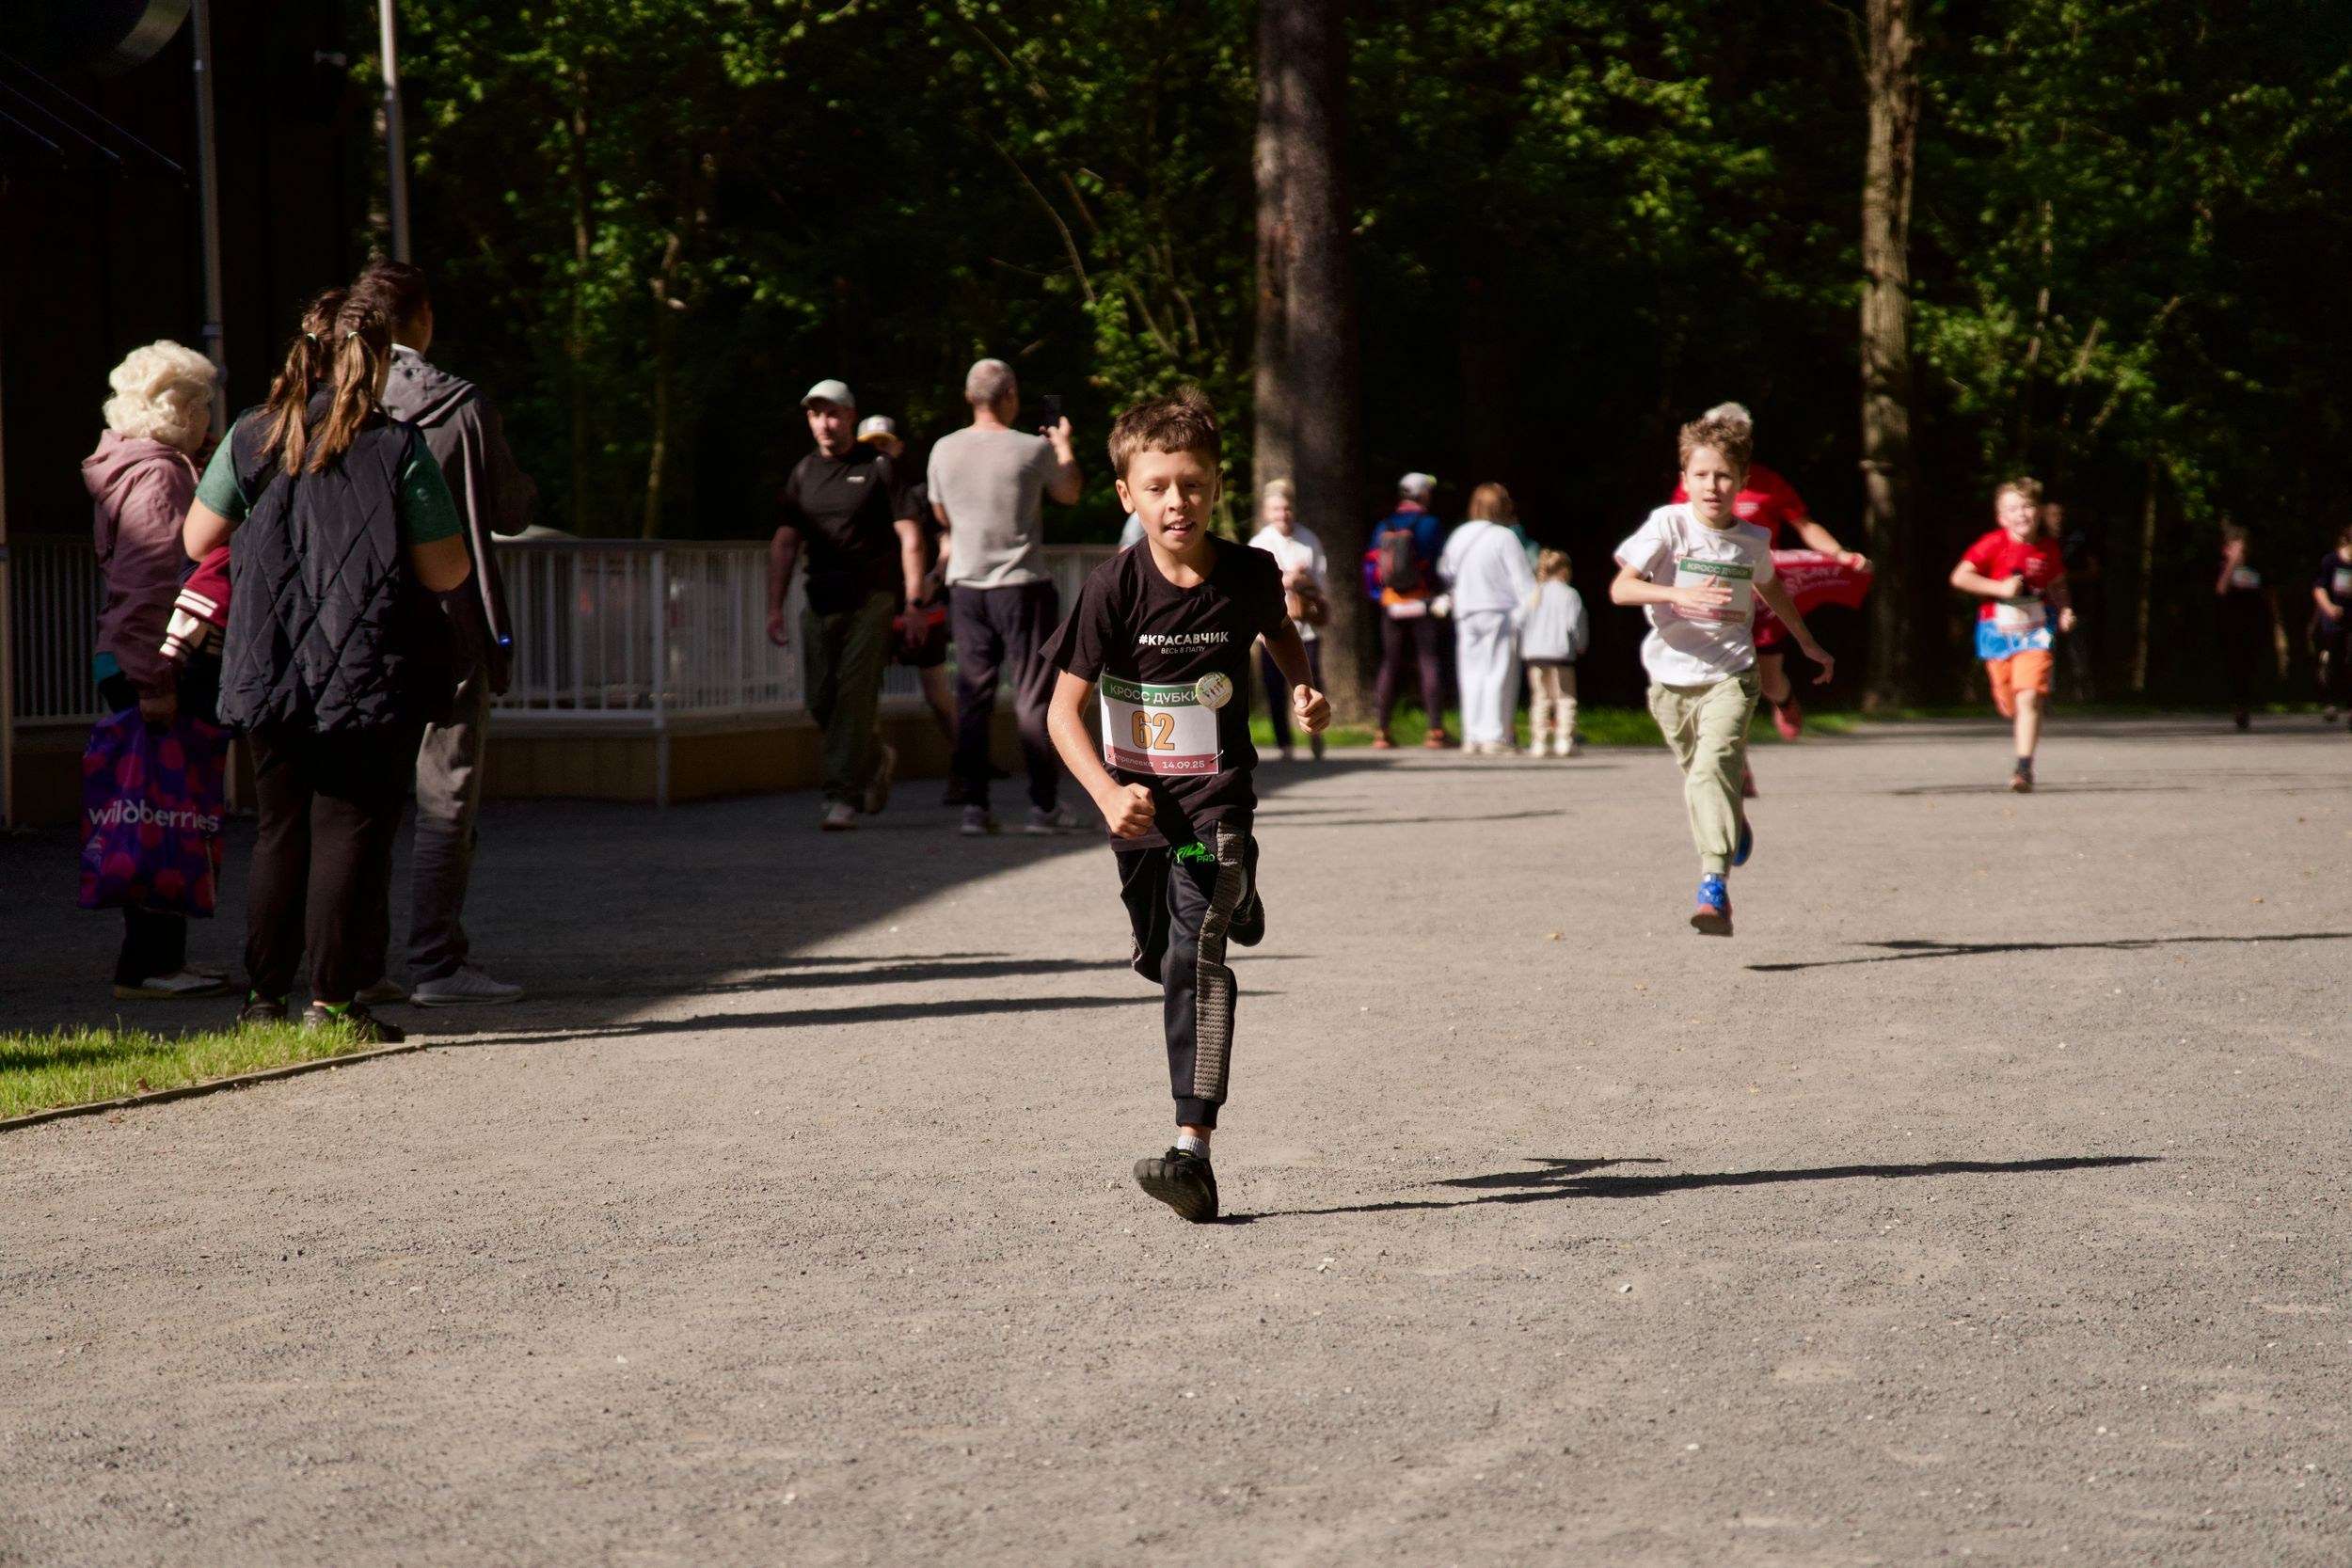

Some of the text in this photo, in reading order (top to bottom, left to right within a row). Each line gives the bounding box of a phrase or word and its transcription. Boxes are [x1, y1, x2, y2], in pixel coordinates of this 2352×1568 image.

[1138, 632, 1230, 646] #КРАСАВЧИК
[1185, 645, 1206, 654] ПАПУ
[1110, 684, 1150, 702] КРОСС
[1131, 710, 1175, 751] 62
[1162, 761, 1205, 769] 14.09.25
[88, 800, 219, 832] wildberries
